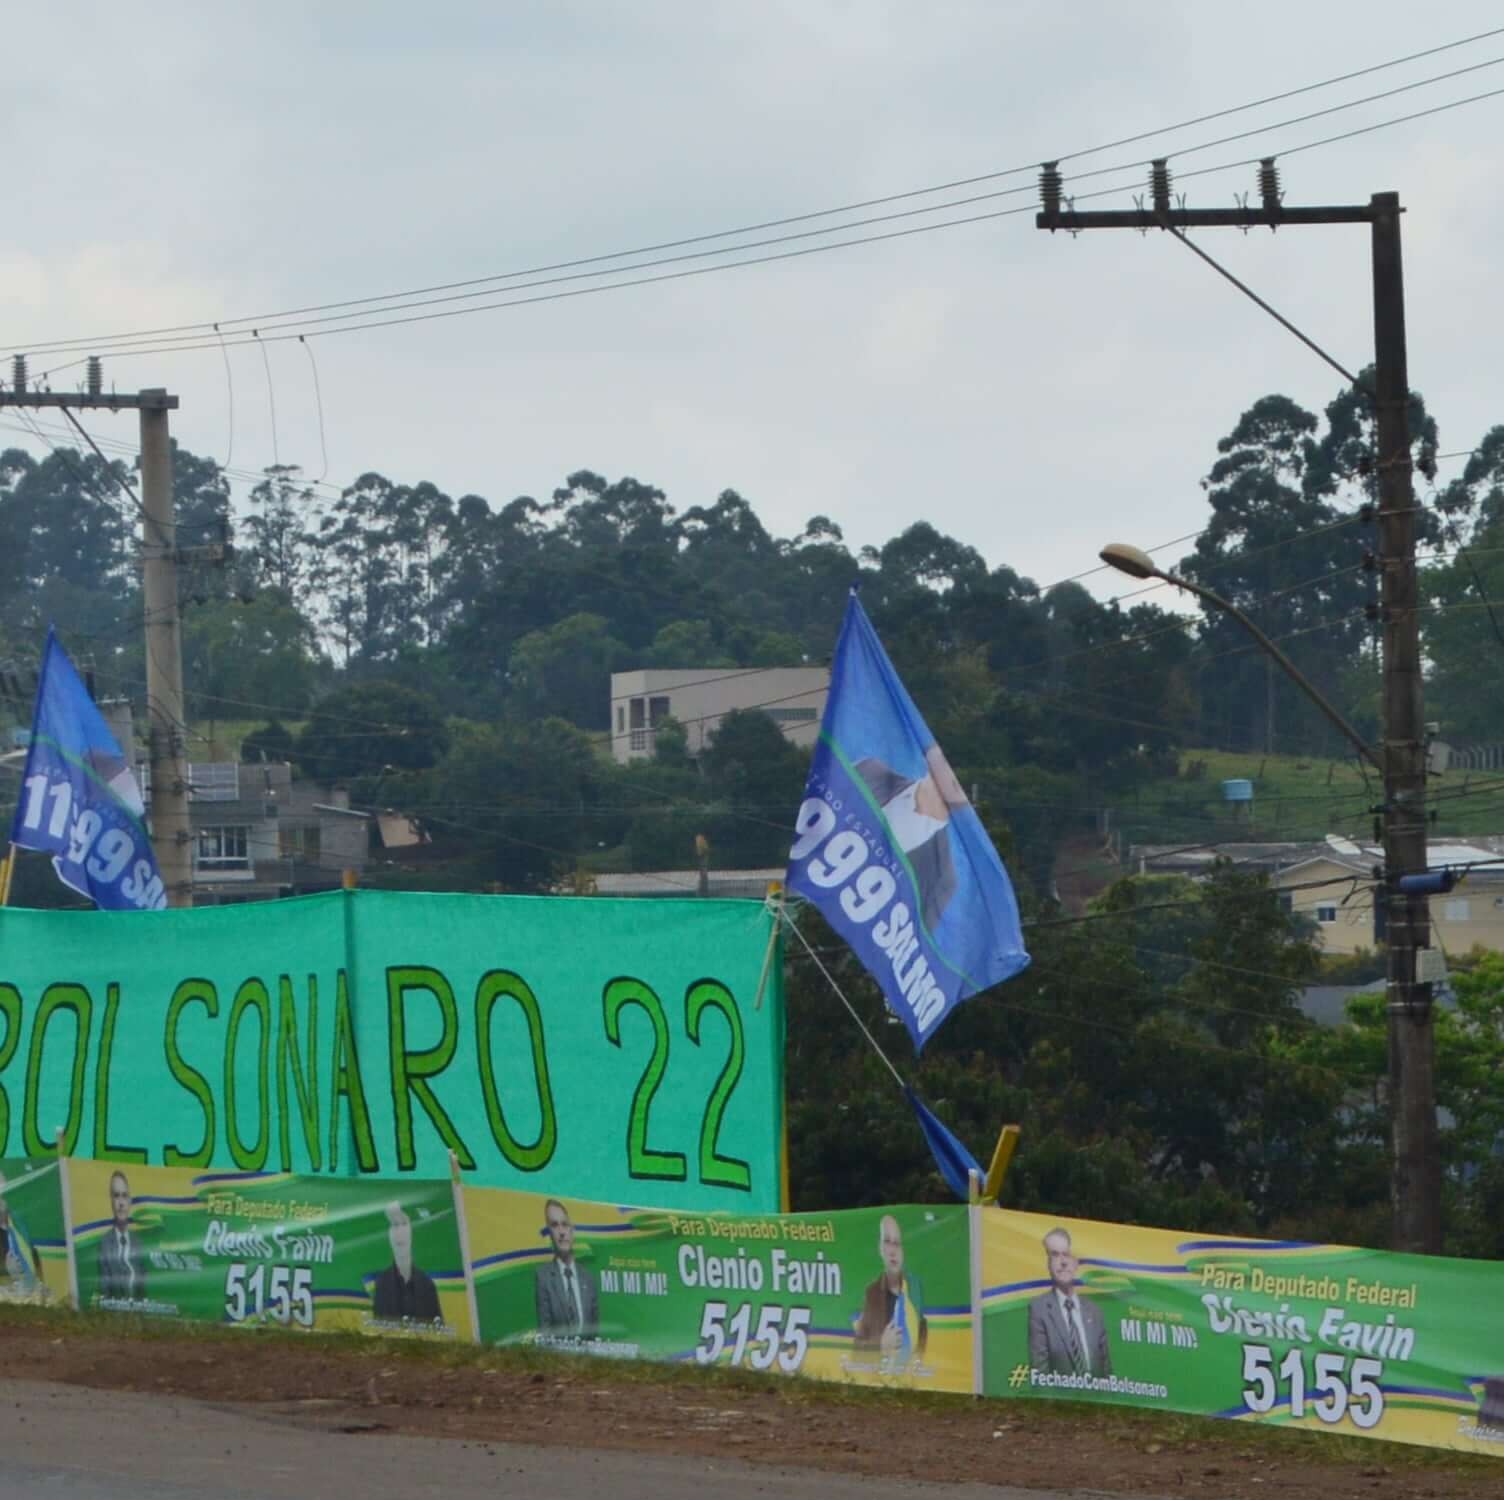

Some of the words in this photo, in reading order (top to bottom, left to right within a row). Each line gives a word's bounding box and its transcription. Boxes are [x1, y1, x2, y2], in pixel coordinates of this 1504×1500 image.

[872, 902, 945, 1033] SALMO
[601, 974, 753, 1193] 22
[277, 1226, 336, 1264] Favin
[669, 1215, 704, 1237] Para
[706, 1217, 777, 1242] Deputado
[778, 1219, 834, 1243] Federal
[224, 1262, 314, 1326] 5155
[600, 1269, 619, 1293] MI
[623, 1271, 641, 1294] MI
[645, 1272, 668, 1296] MI!
[677, 1242, 764, 1291] Clenio
[770, 1246, 842, 1297] Favin
[1201, 1262, 1247, 1292] Para
[1249, 1267, 1342, 1304] Deputado
[1344, 1276, 1417, 1309] Federal
[695, 1299, 812, 1372] 5155
[1120, 1318, 1142, 1343] MI
[1145, 1321, 1168, 1346] MI
[1171, 1324, 1199, 1349] MI!
[1200, 1292, 1313, 1345] Clenio
[1317, 1308, 1416, 1361] Favin
[1008, 1363, 1168, 1399] #FechadoComBolsonaro
[1241, 1343, 1385, 1429] 5155
